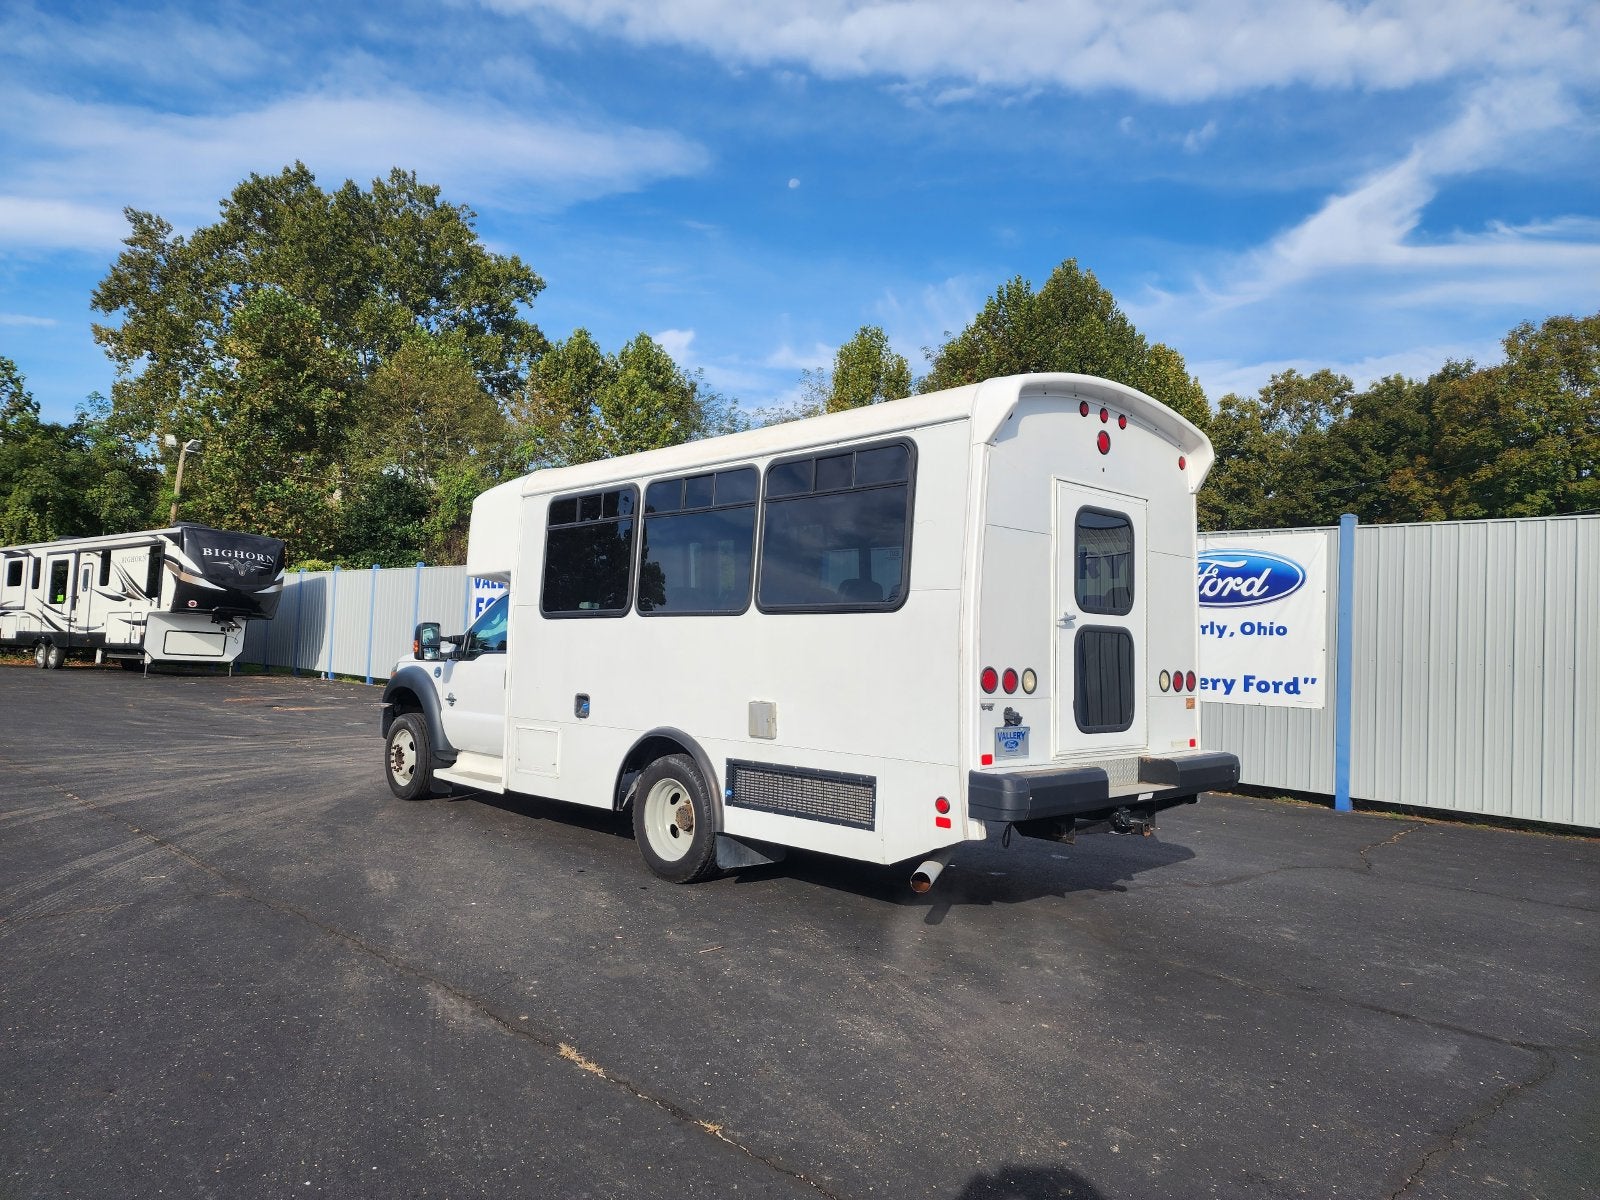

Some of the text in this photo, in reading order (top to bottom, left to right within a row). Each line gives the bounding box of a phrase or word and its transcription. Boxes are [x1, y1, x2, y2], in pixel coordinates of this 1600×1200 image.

[202, 547, 275, 563] BIGHORN
[1198, 559, 1273, 597] Ford
[1240, 621, 1288, 637] Ohio
[1243, 675, 1318, 695] Ford"
[997, 731, 1027, 743] VALLERY
